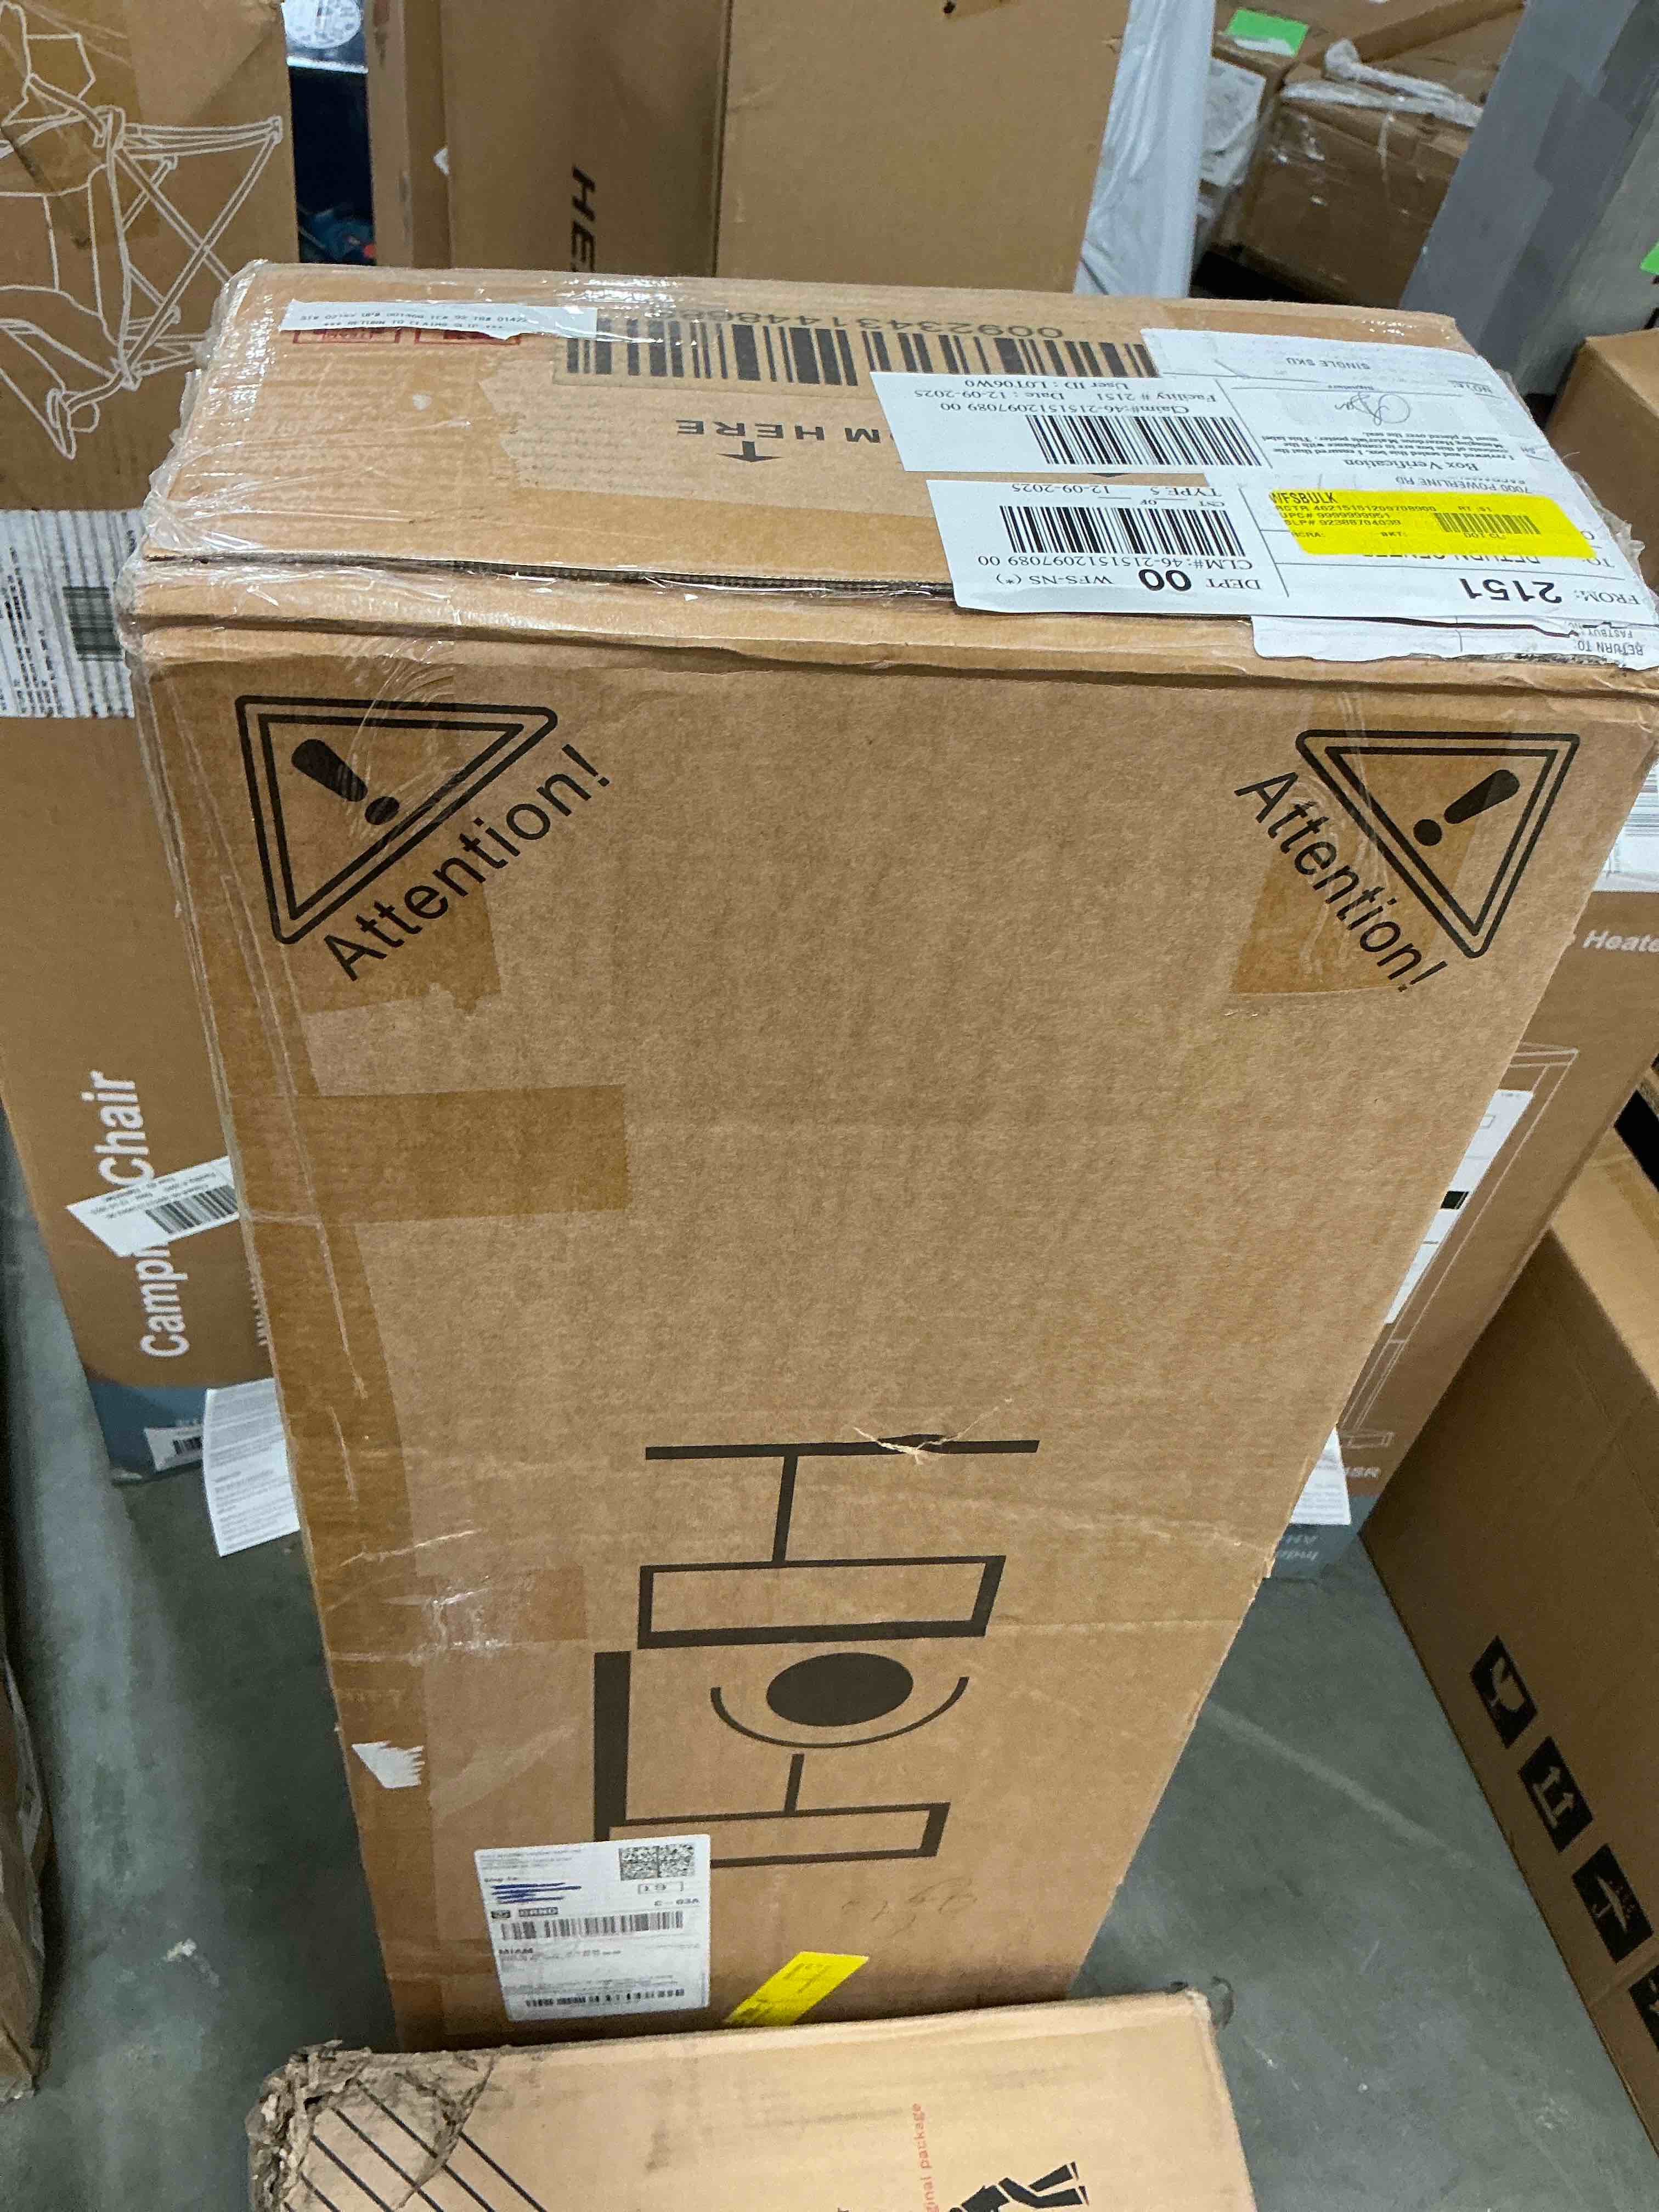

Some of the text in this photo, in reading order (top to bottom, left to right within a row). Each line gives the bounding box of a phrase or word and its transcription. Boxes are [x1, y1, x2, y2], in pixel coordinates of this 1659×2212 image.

[1285, 357, 1370, 370] SINGLE SKU
[1065, 381, 1085, 390] ID
[915, 390, 1006, 399] 12-09-2025
[1097, 393, 1136, 401] 2151
[1157, 392, 1216, 402] Facility
[675, 420, 825, 441] HERE
[1344, 459, 1480, 471] Box Verification
[1395, 476, 1415, 485] RD
[1417, 478, 1497, 491] POWERLINE
[1011, 483, 1221, 498] TYPE 5 12-09-2025
[978, 555, 1000, 566] 00
[1028, 574, 1114, 585] WFS-NS
[1138, 569, 1192, 592] 00
[1206, 578, 1262, 590] DEPT
[1458, 578, 1640, 605] FROM: 2151
[1596, 641, 1644, 656] RETURN
[324, 744, 610, 981] Attention!
[1234, 771, 1448, 992] Attention!
[81, 1070, 155, 1186] Chair
[912, 2103, 933, 2169] package
